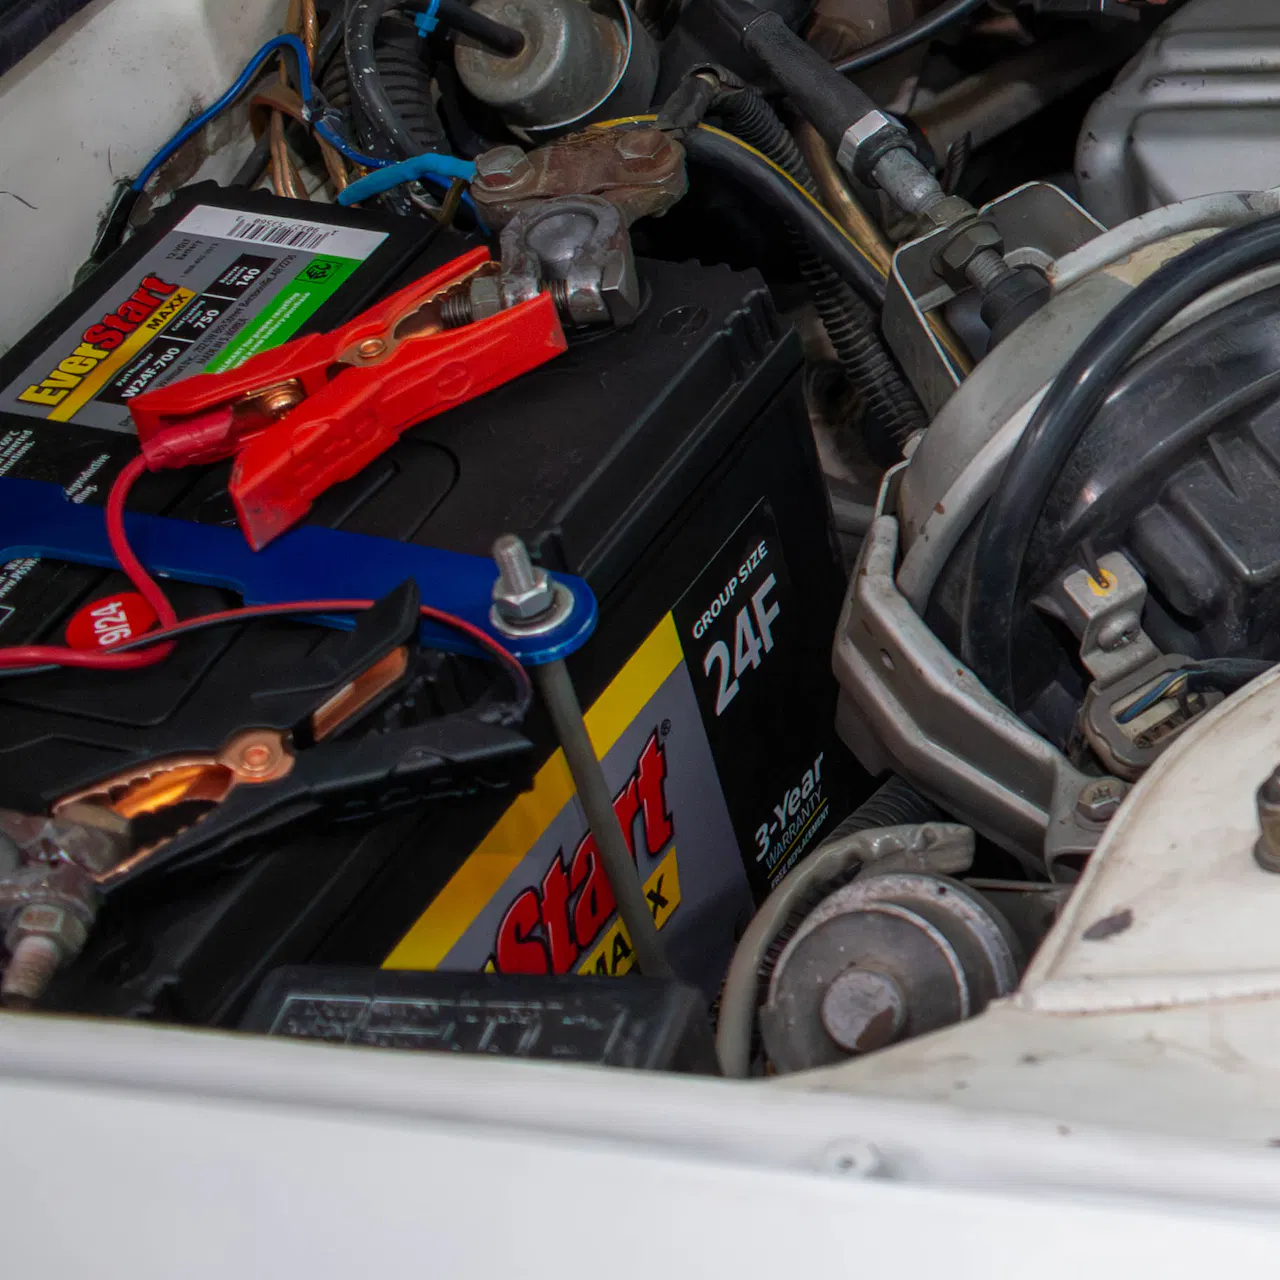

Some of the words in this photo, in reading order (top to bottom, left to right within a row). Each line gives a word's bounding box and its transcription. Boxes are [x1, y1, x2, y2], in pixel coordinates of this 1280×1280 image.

[226, 266, 249, 286] Capacity
[236, 268, 260, 287] 140
[17, 275, 177, 407] EverStart
[146, 293, 190, 331] MAXX
[193, 309, 219, 329] 750
[121, 347, 181, 398] W24F-700
[692, 577, 739, 640] GROUP
[738, 539, 768, 582] SIZE
[90, 601, 133, 646] 9/24
[704, 572, 781, 717] 24F
[754, 751, 824, 863] 3-Year
[765, 784, 822, 871] WARRANTY
[787, 804, 830, 866] REPLACEMENT
[483, 724, 675, 975] Start
